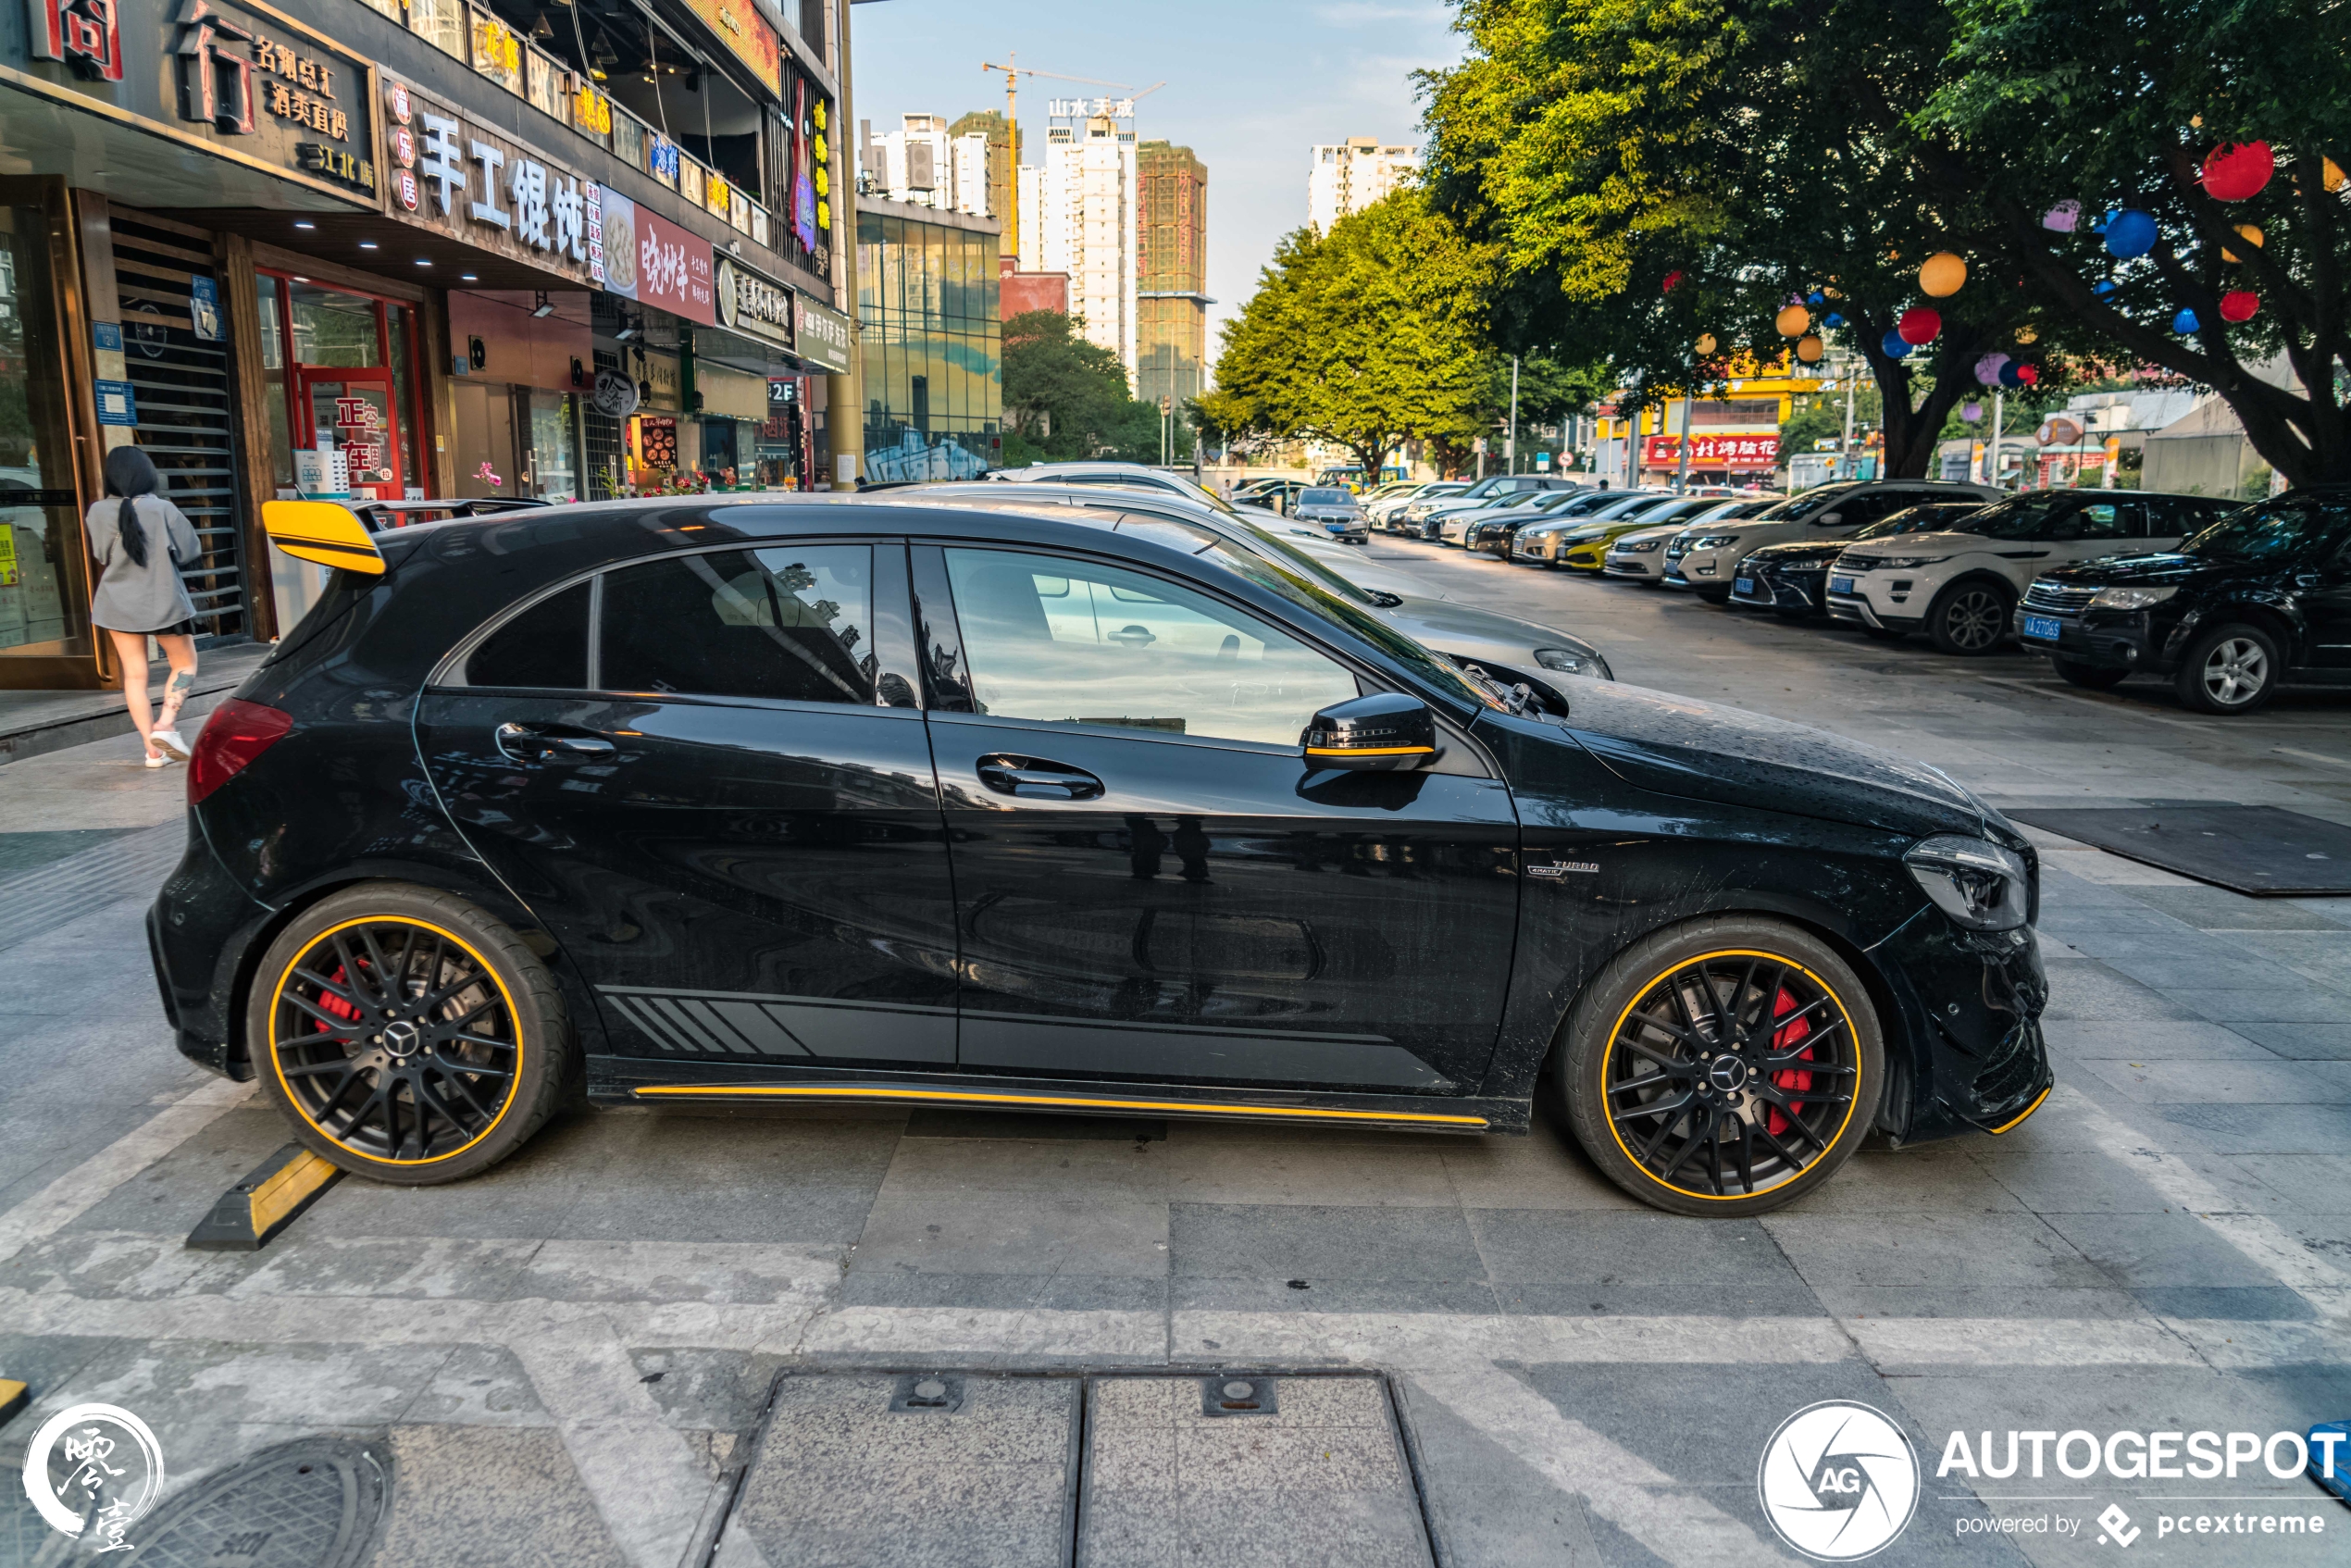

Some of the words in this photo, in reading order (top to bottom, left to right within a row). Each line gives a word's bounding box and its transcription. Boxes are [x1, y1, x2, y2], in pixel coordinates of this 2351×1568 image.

[270, 81, 349, 143] 酒类直供
[1049, 98, 1135, 118] 山水天成
[317, 143, 374, 188] 江北店
[423, 110, 587, 263] 手工馄饨
[773, 382, 793, 402] 2F
[1532, 867, 1559, 876] 4MATIC
[1552, 860, 1600, 872] TURBO
